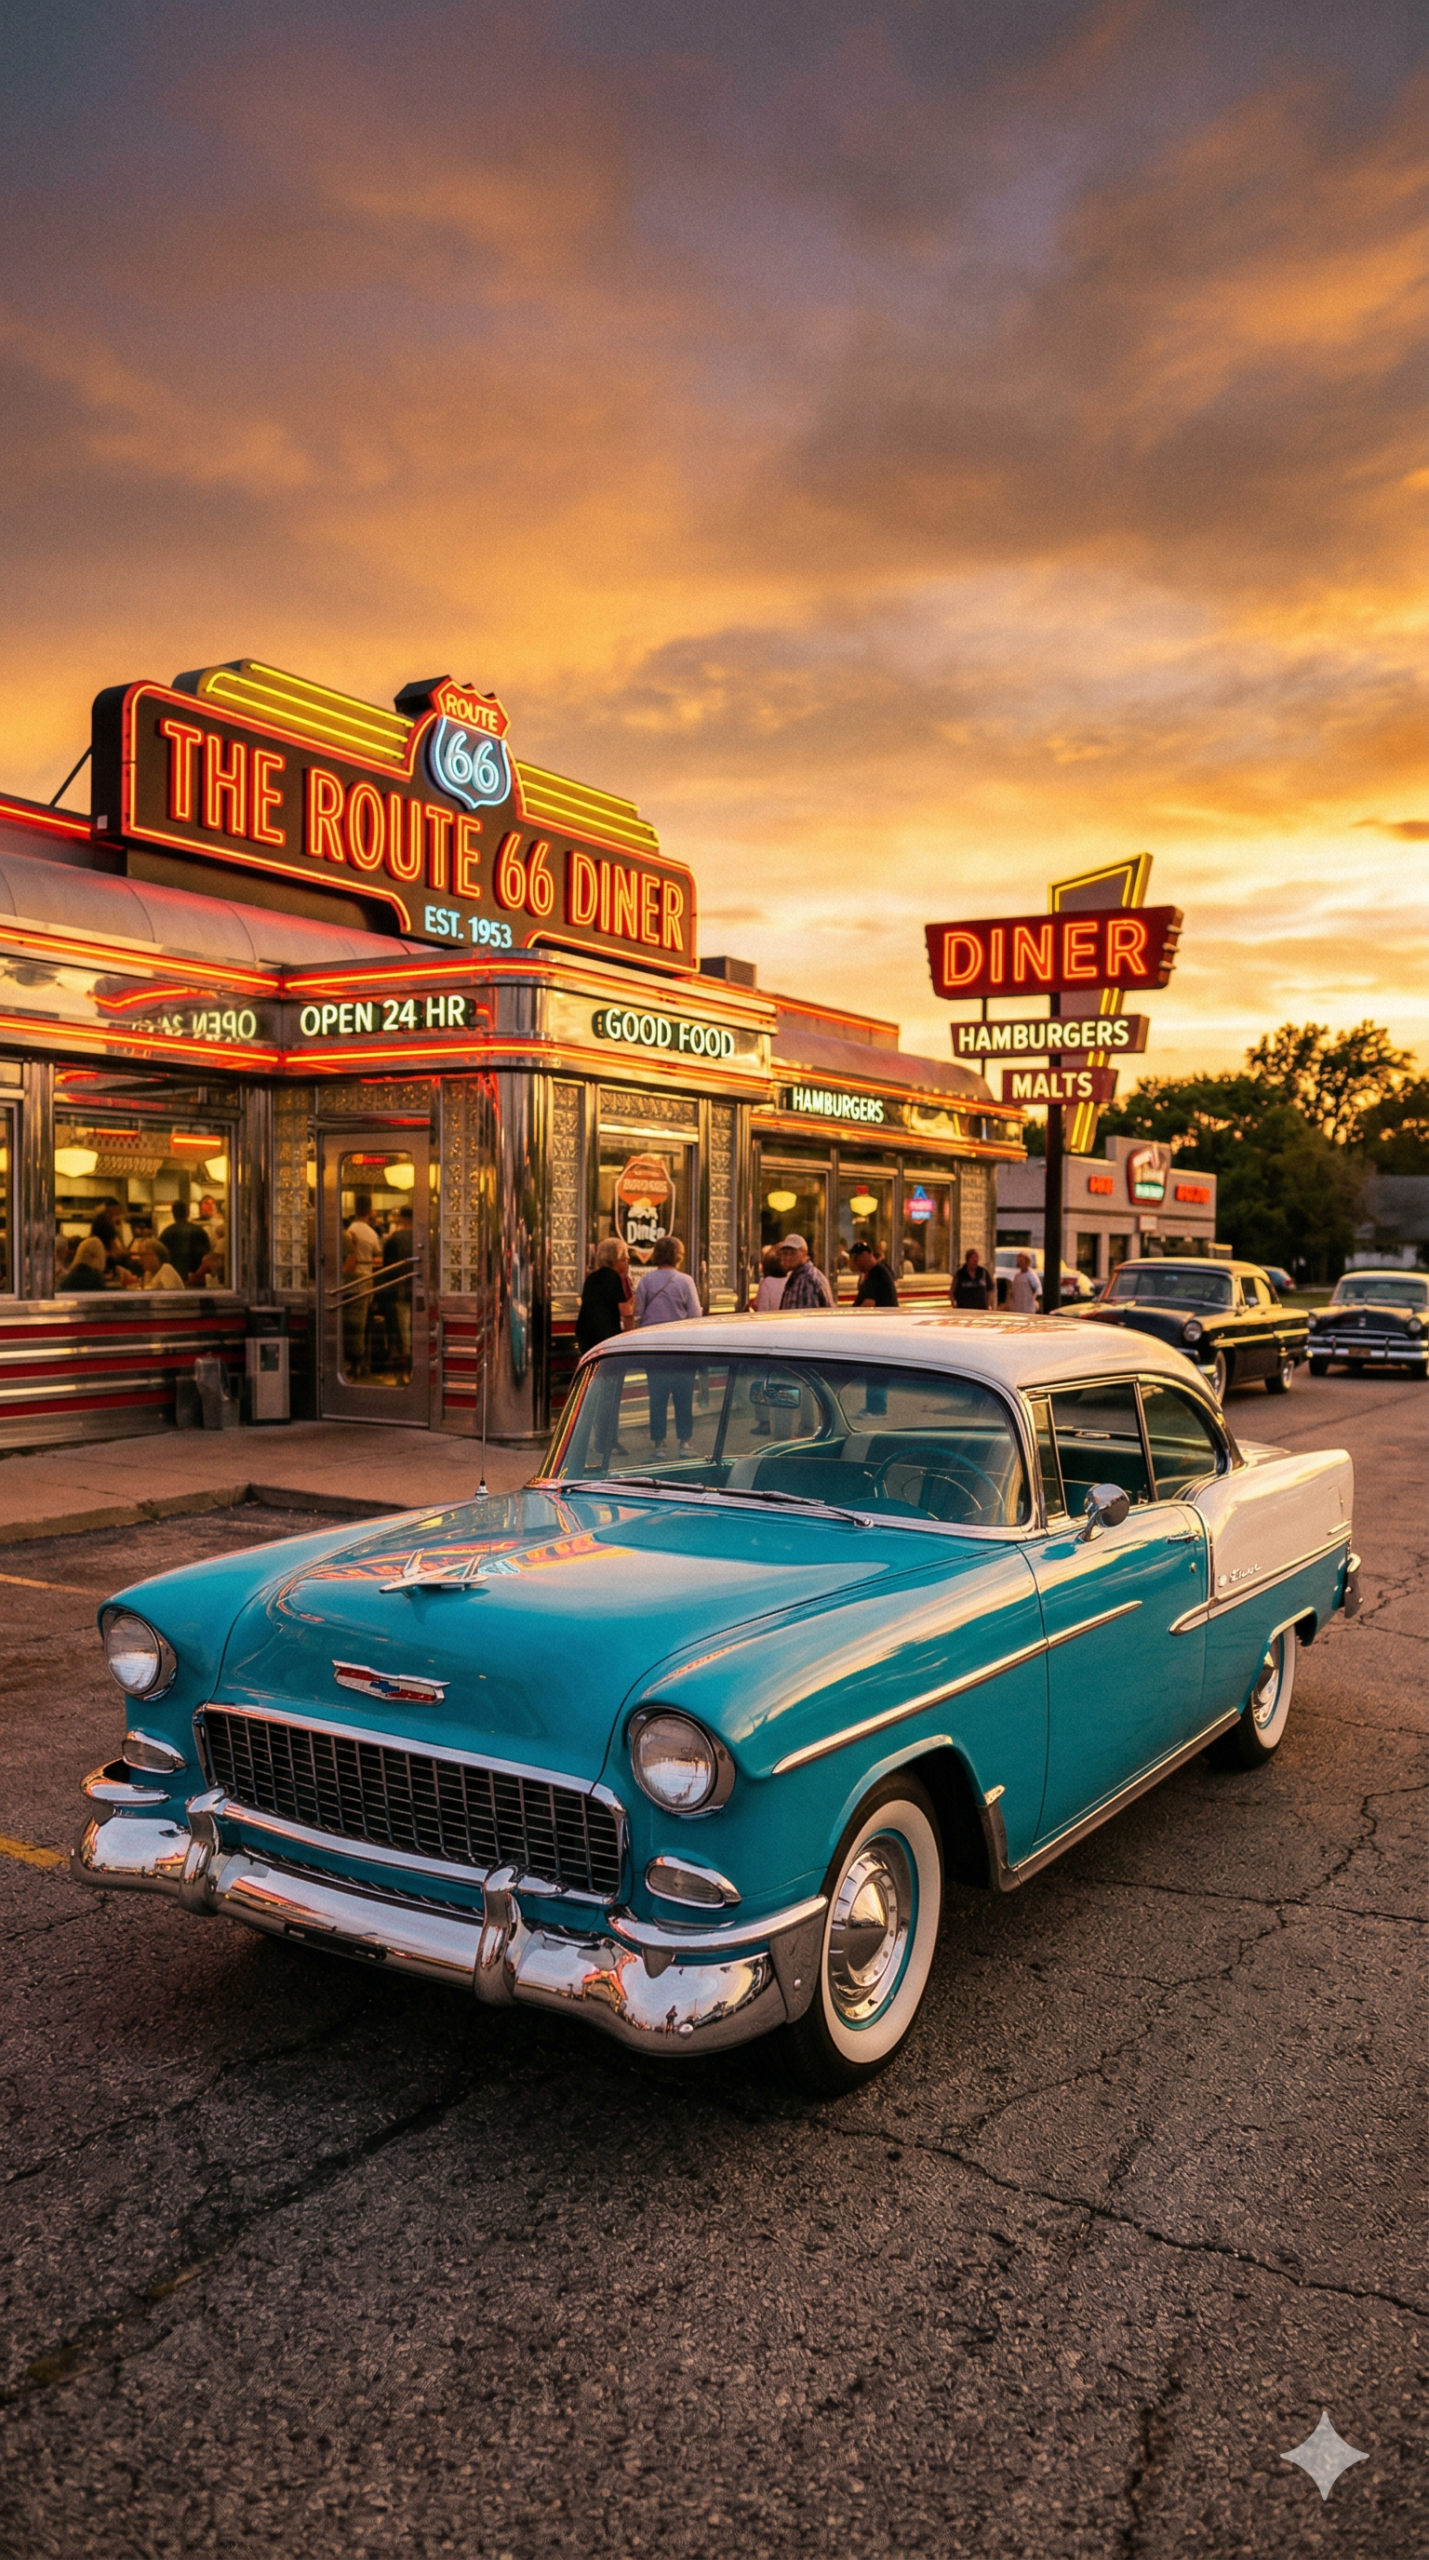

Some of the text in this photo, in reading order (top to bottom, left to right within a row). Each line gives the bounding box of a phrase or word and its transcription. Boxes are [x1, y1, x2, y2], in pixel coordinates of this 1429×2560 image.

[445, 693, 498, 732] ROUTE
[444, 731, 499, 795] 66
[162, 717, 685, 951] THE ROUTE 66 DINER
[423, 905, 512, 949] EST. 1953
[943, 919, 1148, 987] DINER
[300, 994, 466, 1037] OPEN 24 HR
[605, 1008, 734, 1059] GOOD FOOD
[958, 1019, 1130, 1053] HAMBURGERS
[793, 1087, 884, 1124] HAMBURGERS
[1012, 1071, 1094, 1099] MALTS
